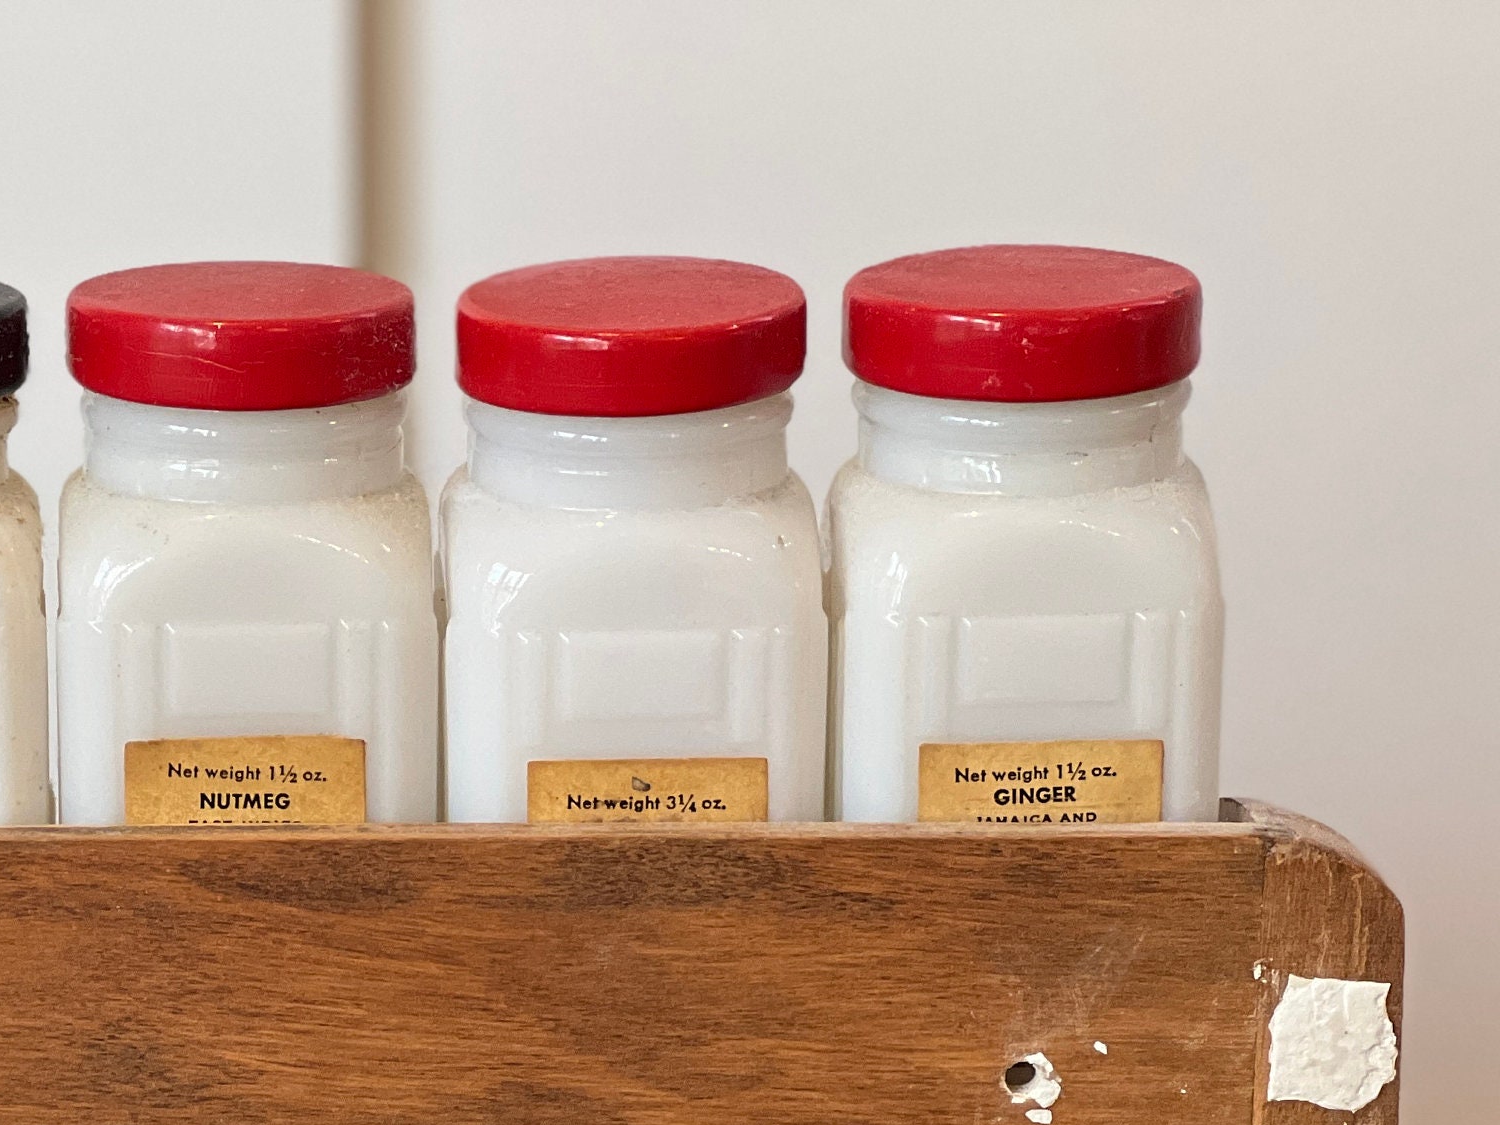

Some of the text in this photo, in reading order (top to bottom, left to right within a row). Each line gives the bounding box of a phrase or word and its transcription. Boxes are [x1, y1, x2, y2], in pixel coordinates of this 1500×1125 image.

[168, 763, 199, 778] Net
[205, 766, 261, 782] weight
[303, 772, 327, 782] oz.
[955, 768, 986, 783] Net
[992, 766, 1049, 783] weight
[1091, 766, 1117, 777] oz.
[200, 793, 290, 809] NUTMEG
[567, 794, 599, 809] Net
[604, 796, 660, 812] weight
[701, 800, 726, 810] oz.
[993, 786, 1076, 806] GINGER
[1060, 812, 1097, 823] AND
